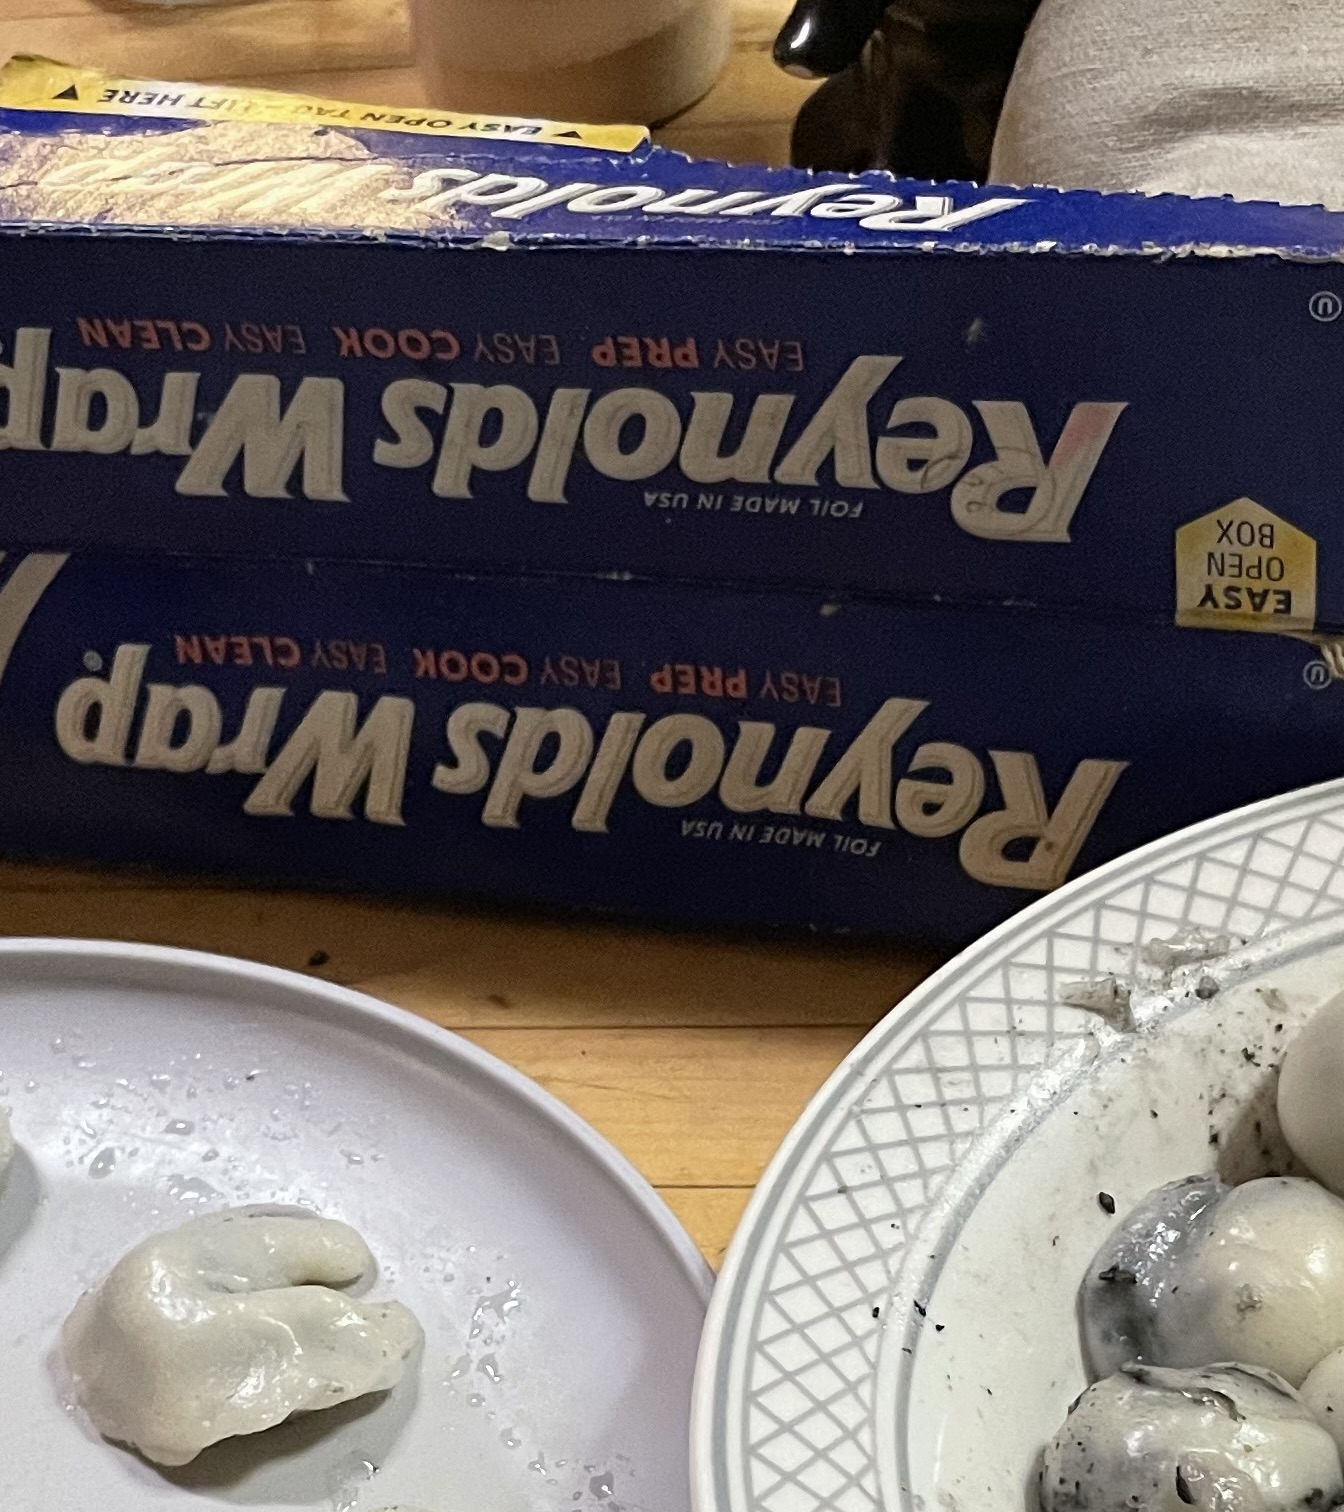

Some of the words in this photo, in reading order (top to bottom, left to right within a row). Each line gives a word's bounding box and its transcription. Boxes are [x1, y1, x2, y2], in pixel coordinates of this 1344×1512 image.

[97, 89, 185, 107] HERE
[360, 111, 453, 130] OPEN
[469, 121, 543, 137] EASY
[380, 166, 1030, 233] Reynolds
[75, 316, 212, 352] CLEAN
[222, 321, 305, 356] EASY
[332, 324, 461, 362] COOK
[473, 331, 561, 366] EASY
[591, 334, 700, 370] PREP
[710, 337, 805, 371] EASY
[372, 355, 1131, 543] Reynolds
[642, 491, 690, 511] USA
[697, 493, 725, 512] IN
[729, 495, 802, 517] MADE
[808, 498, 865, 520] FOIL
[1215, 519, 1275, 549] BOX
[1206, 551, 1285, 582] OPEN
[1196, 583, 1293, 616] EASY
[174, 632, 301, 668] CLEAN
[310, 638, 388, 676] EASY
[413, 648, 530, 687] COOK
[541, 654, 622, 691] EASY
[649, 662, 750, 701] PREP
[759, 670, 842, 708] EASY
[55, 644, 416, 828] Wrap
[431, 697, 1133, 892] Reynolds
[680, 818, 725, 841] USA
[727, 822, 757, 842] IN
[758, 825, 828, 849] MADE
[833, 834, 883, 858] FOIL
